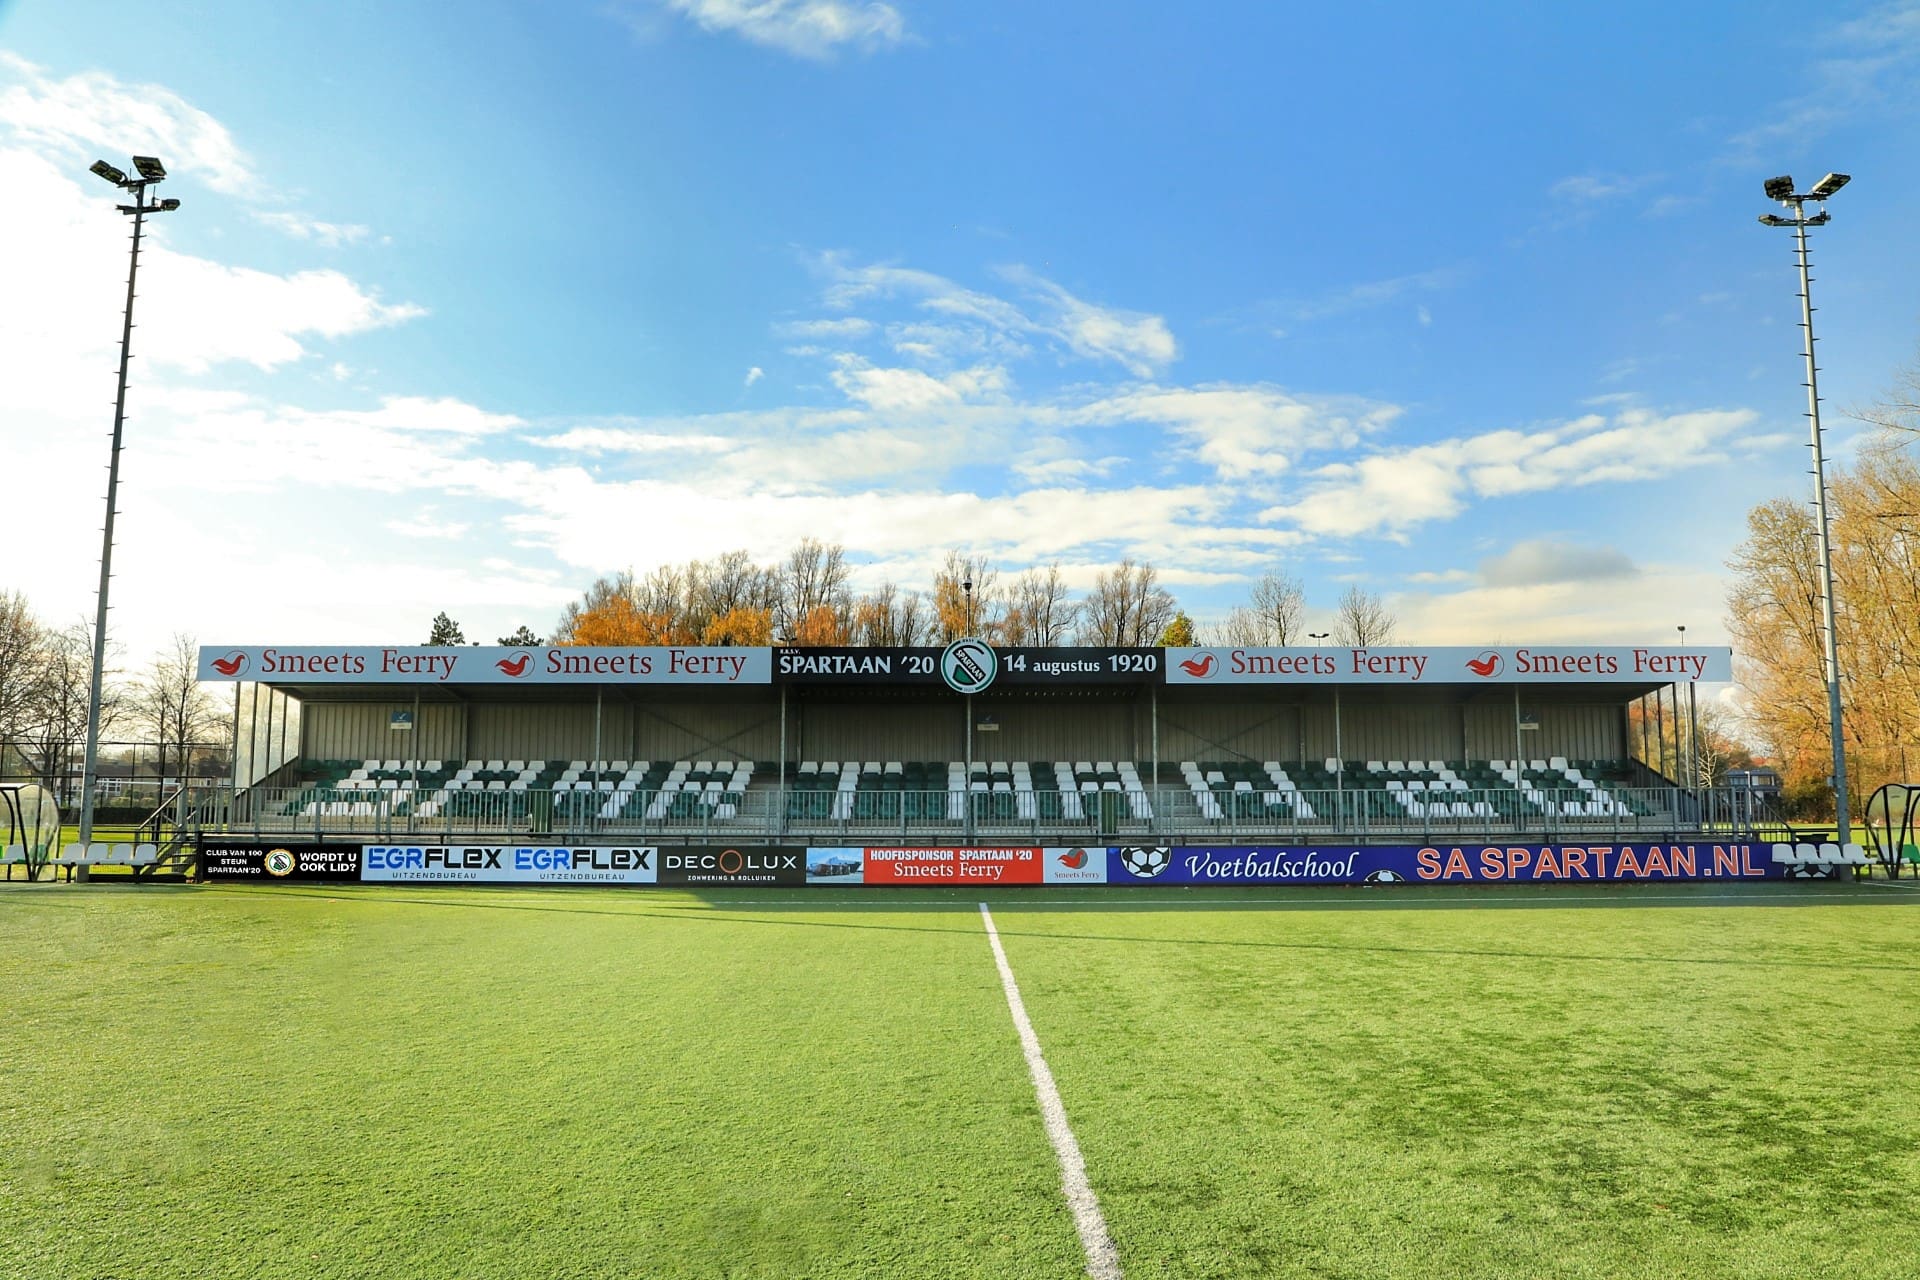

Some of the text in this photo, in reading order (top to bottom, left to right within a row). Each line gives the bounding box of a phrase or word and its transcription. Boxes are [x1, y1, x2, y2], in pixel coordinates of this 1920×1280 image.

[261, 649, 459, 680] Smeets Ferry
[547, 649, 747, 680] Smeets Ferry
[779, 655, 891, 674] SPARTAAN
[955, 649, 984, 680] SPARTAAN
[1003, 654, 1157, 674] 14 augustus 1920
[1230, 649, 1428, 681] Smeets Ferry
[1515, 649, 1707, 680] Smeets Ferry
[300, 853, 357, 861] WORDT U
[300, 863, 356, 871] OOK LID?
[667, 849, 797, 874] DECOLUX
[870, 850, 954, 861] HOOFDSPONSOR
[959, 850, 1013, 861] SPARTAAN
[1184, 851, 1360, 878] Voetbalschool
[1416, 848, 1473, 879] SA
[894, 863, 1004, 880] Smeets Ferry
[1054, 871, 1100, 880] Smeets Ferry
